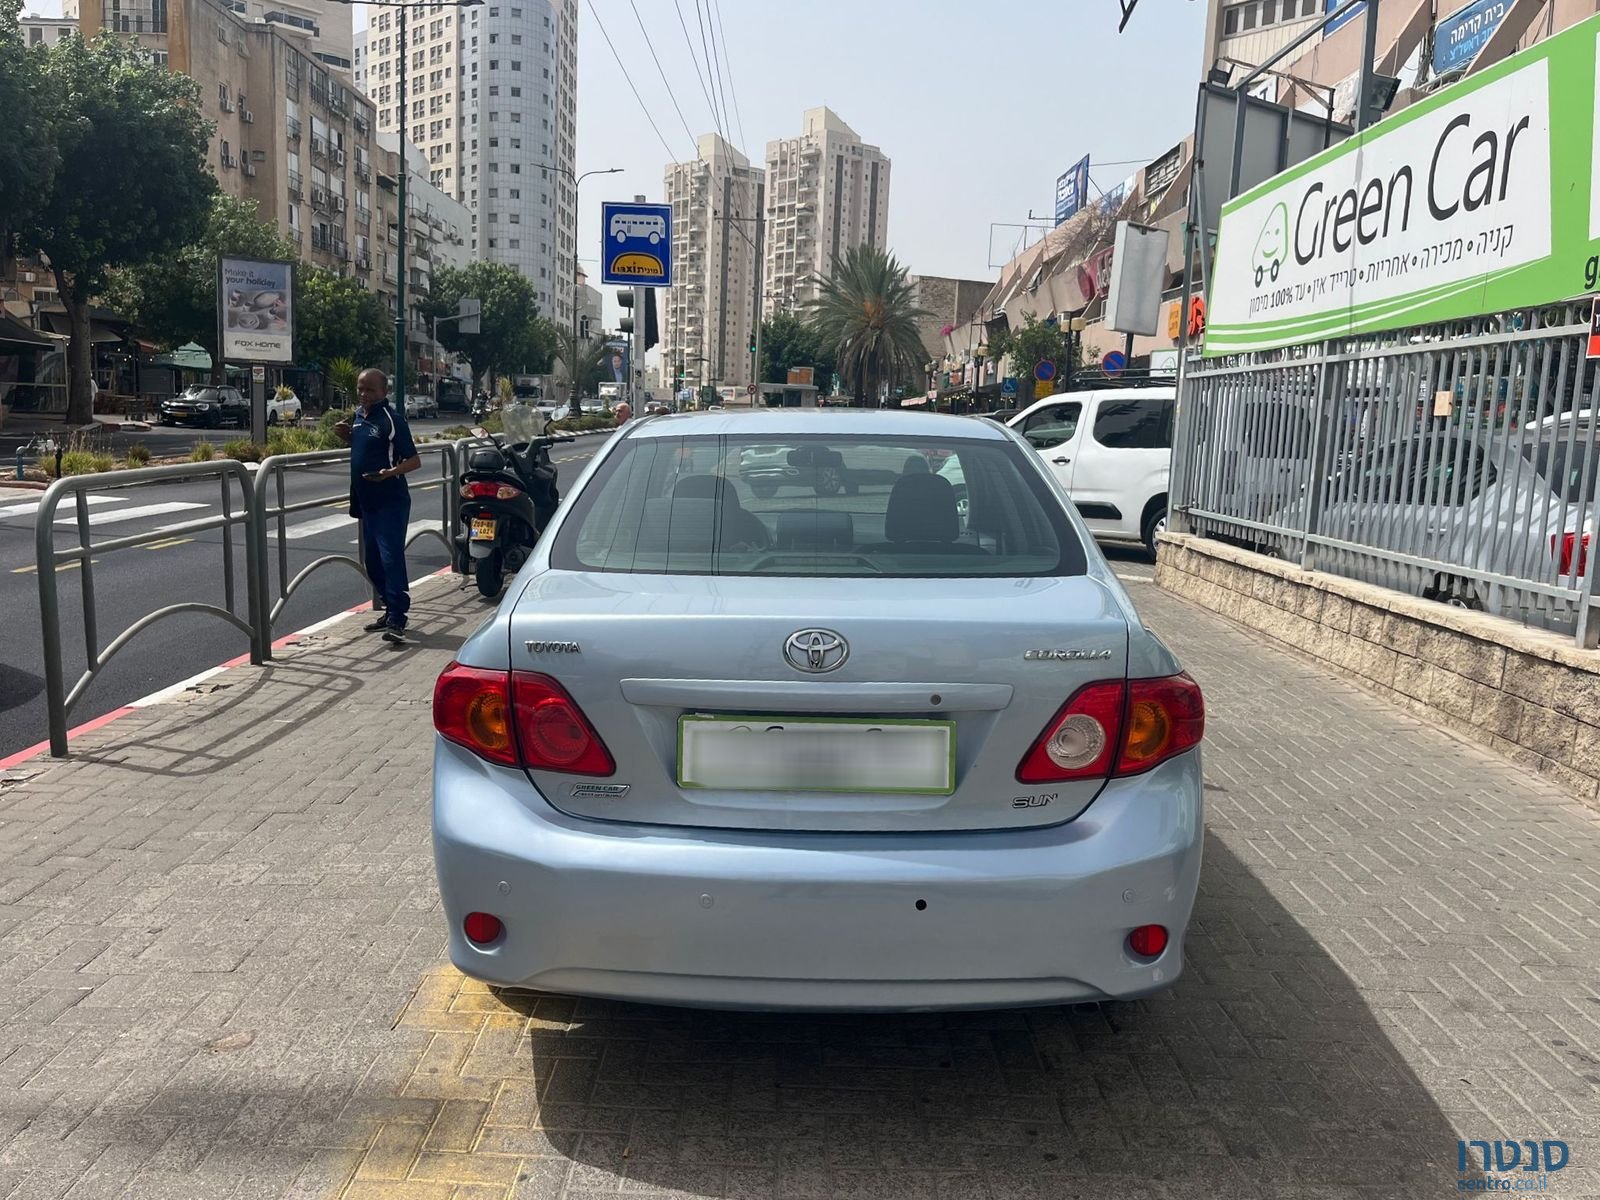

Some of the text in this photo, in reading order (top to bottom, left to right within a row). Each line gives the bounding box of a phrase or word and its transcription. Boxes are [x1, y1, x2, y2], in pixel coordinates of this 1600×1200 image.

[1450, 2, 1504, 45] בית קדימה
[1294, 113, 1530, 266] Green Car
[224, 268, 247, 276] Make
[1249, 224, 1514, 319] קניה מכירה אחריות טרייד אין עד 100% מימון
[225, 276, 276, 288] your holiday
[524, 640, 581, 654] TOYOTA
[1023, 647, 1112, 661] COROLLA
[1012, 792, 1058, 809] SUN
